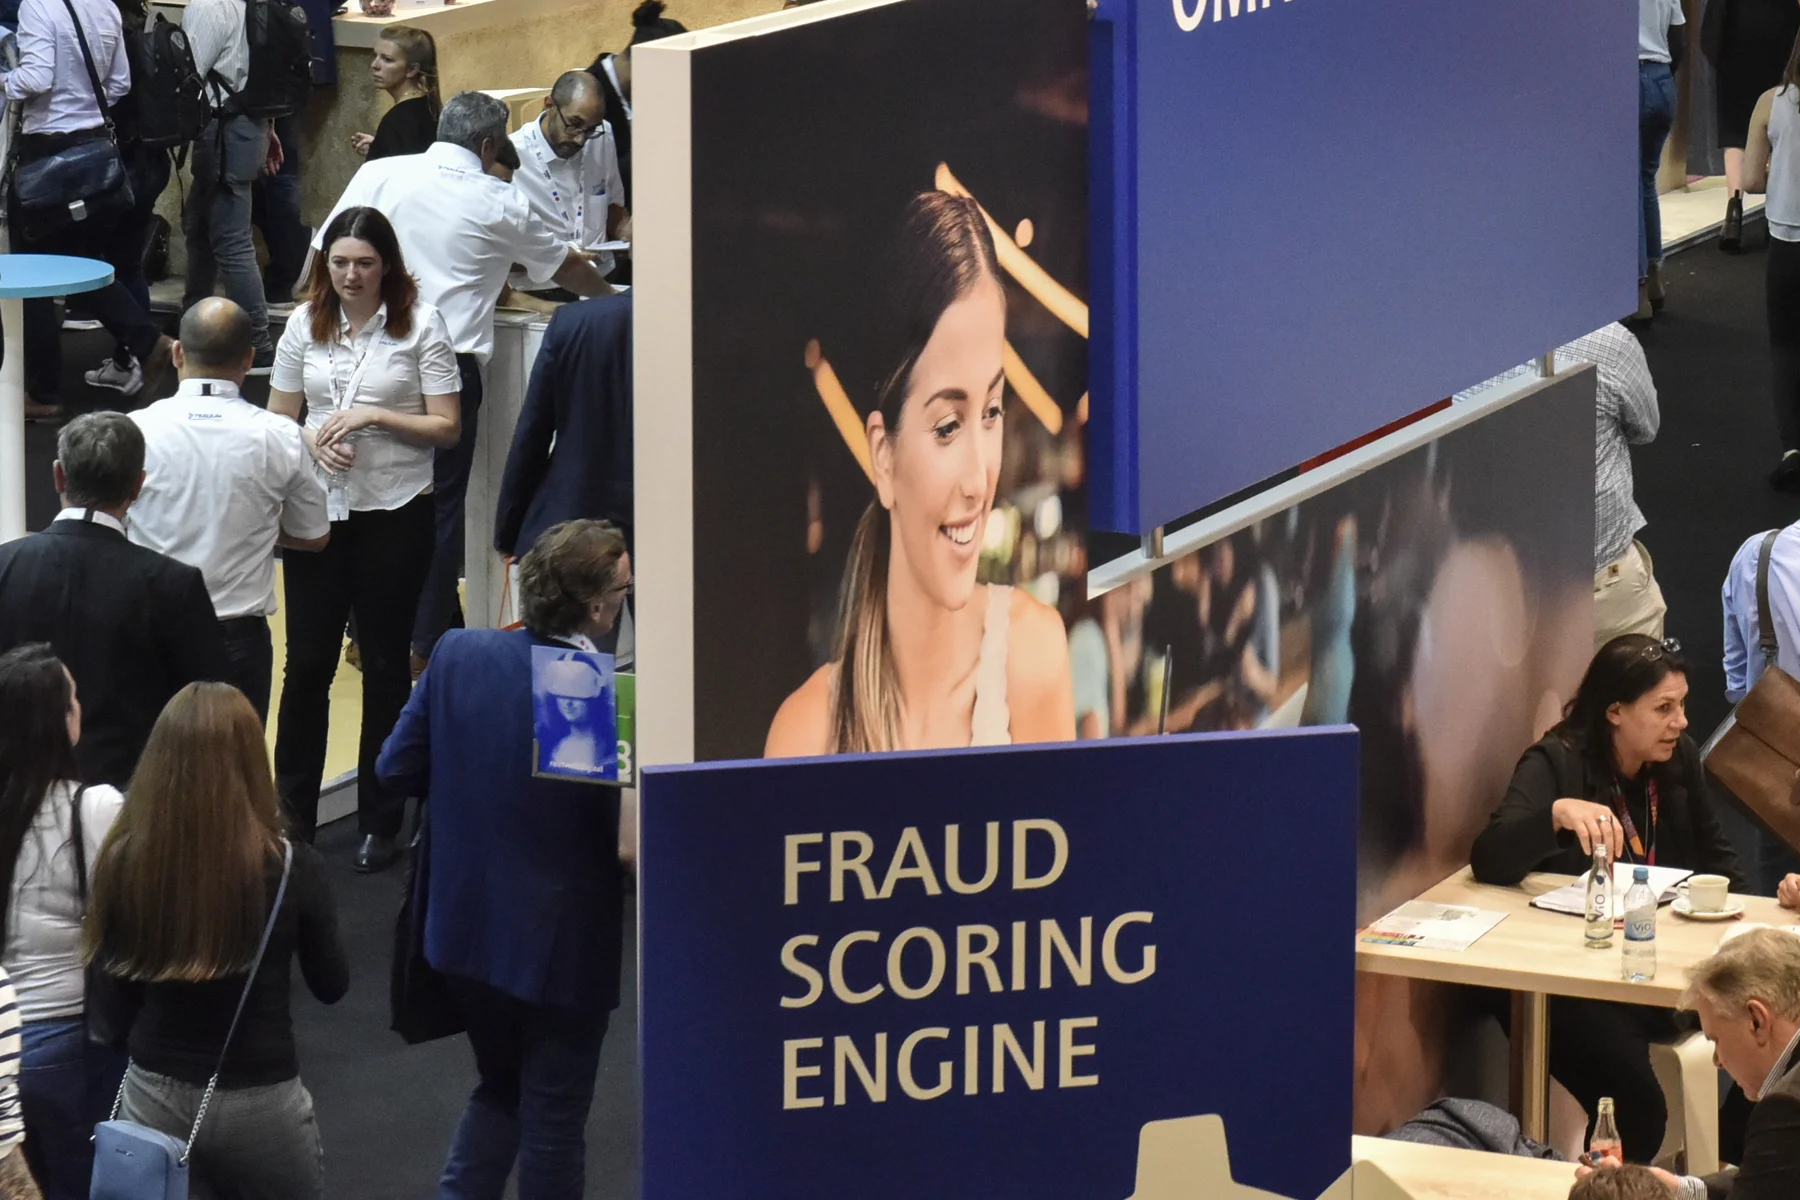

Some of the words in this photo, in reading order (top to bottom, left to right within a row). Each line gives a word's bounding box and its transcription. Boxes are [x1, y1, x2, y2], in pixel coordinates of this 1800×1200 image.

[784, 818, 1069, 907] FRAUD
[780, 911, 1158, 1009] SCORING
[783, 1016, 1100, 1111] ENGINE
